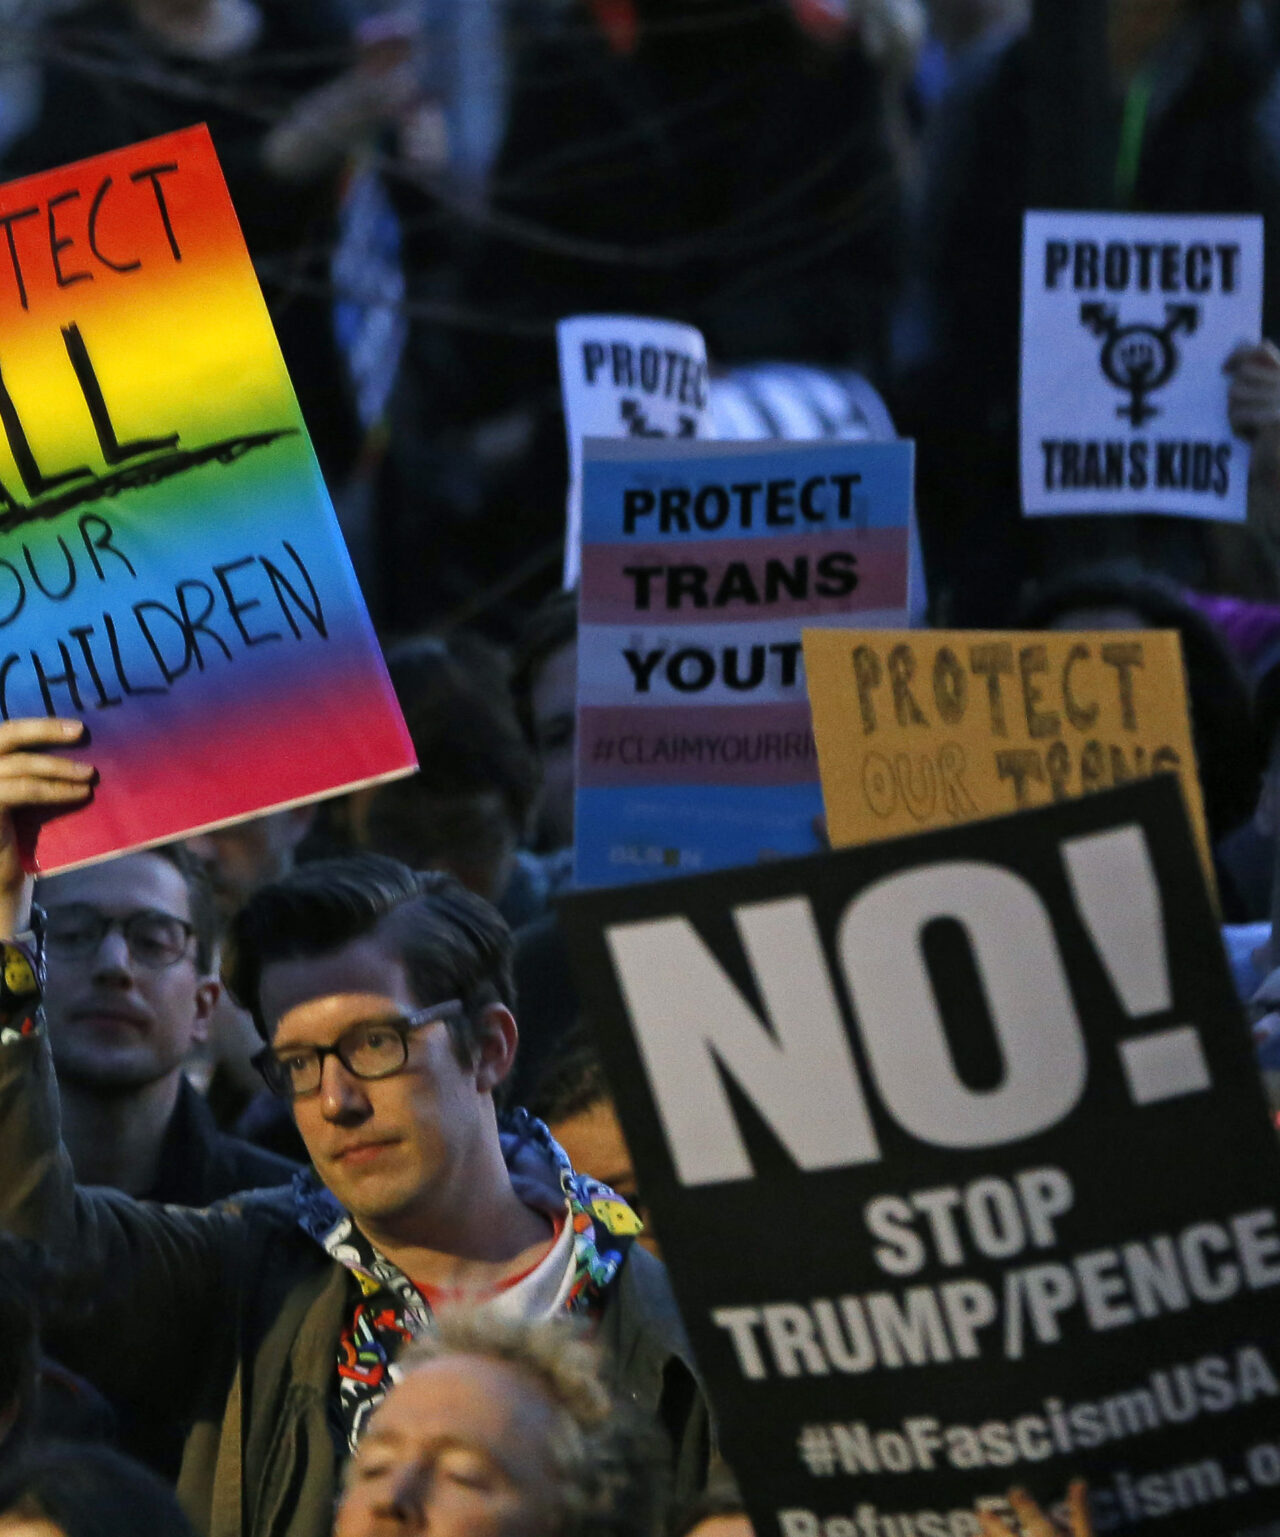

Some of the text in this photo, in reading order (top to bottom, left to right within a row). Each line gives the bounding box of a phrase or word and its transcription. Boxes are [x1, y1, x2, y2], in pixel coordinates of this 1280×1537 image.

[1043, 239, 1240, 293] PROTECT
[582, 340, 707, 411] PROTEC
[623, 472, 862, 534] PROTECT
[1041, 440, 1230, 498] TRANS KIDS
[623, 551, 859, 611] TRANS
[622, 641, 802, 693] YOUT
[852, 640, 1144, 739] PROTECT
[593, 731, 816, 766] #CLAIMYOURRI
[862, 741, 981, 823] OUR
[605, 823, 1212, 1189] NO!
[863, 1165, 1074, 1277] STOP
[712, 1207, 1280, 1381] TRUMP/PENCE
[798, 1345, 1280, 1476] #NoFascismUSA
